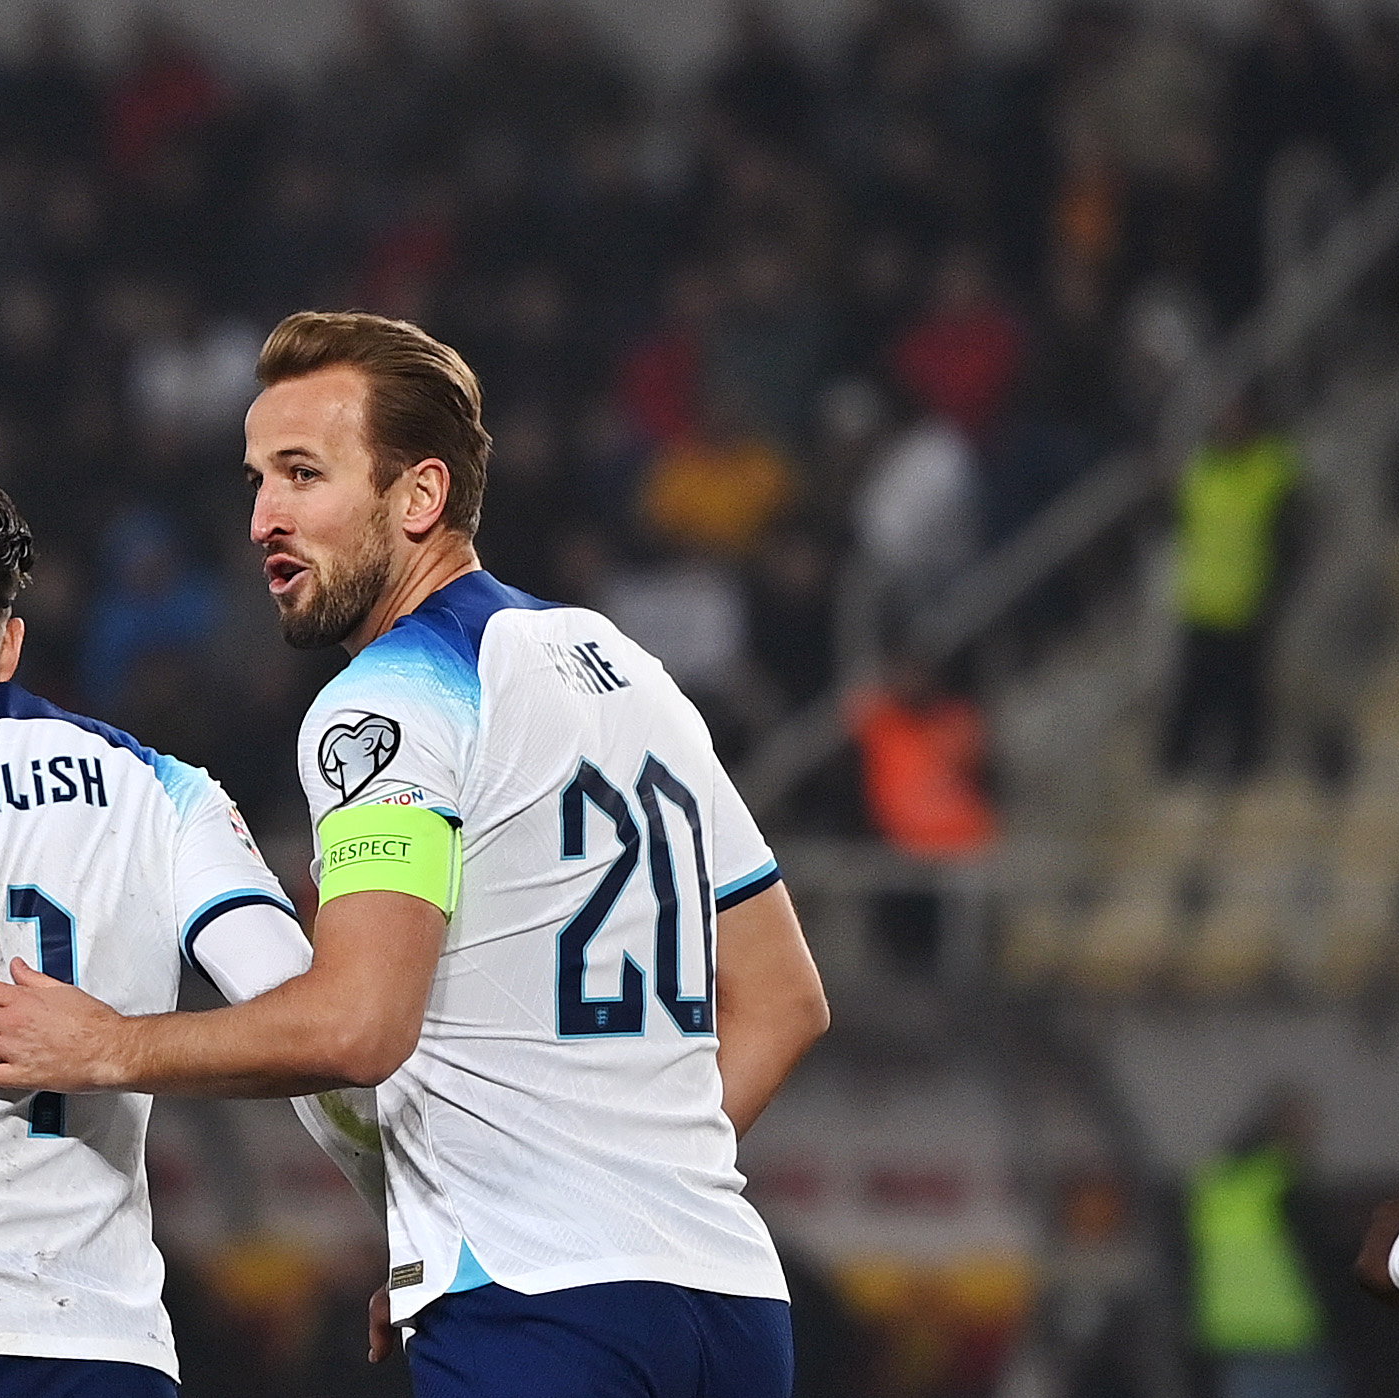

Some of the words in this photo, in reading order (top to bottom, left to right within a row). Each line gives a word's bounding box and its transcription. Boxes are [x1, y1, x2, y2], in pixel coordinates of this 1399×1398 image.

[376, 789, 424, 806] TION
[329, 840, 412, 867] RESPECT
[555, 750, 716, 1039] 20
